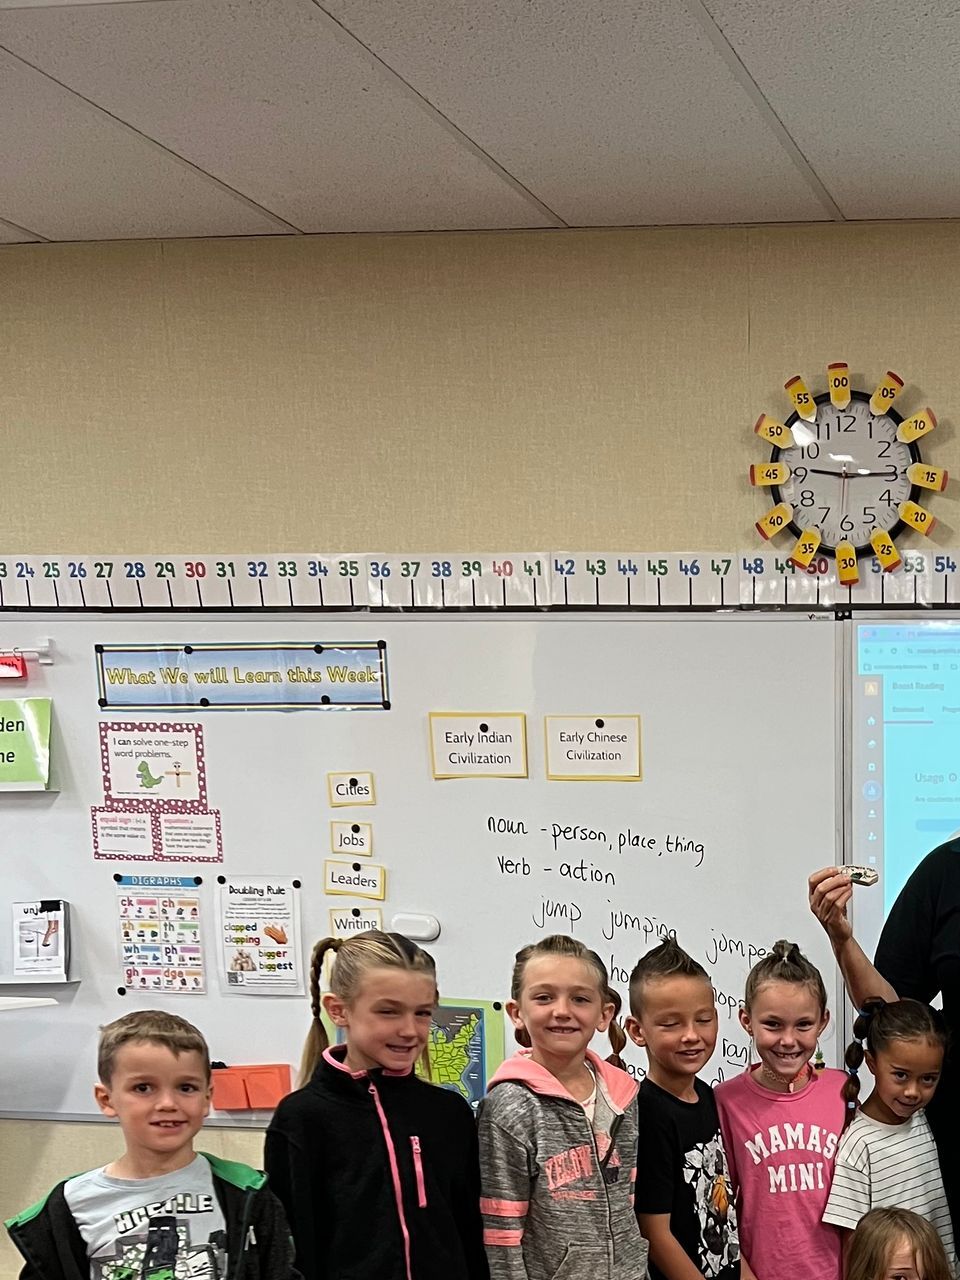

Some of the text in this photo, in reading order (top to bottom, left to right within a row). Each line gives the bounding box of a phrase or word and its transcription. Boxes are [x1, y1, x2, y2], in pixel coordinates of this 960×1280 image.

[816, 423, 831, 440] 11
[836, 416, 856, 432] 12
[800, 442, 819, 460] 10
[878, 441, 891, 458] 2
[794, 467, 808, 484] 9
[800, 490, 815, 507] 8
[879, 490, 894, 507] 4
[818, 507, 830, 524] 7
[840, 515, 854, 532] 6
[863, 507, 876, 524] 5
[16, 563, 34, 577] 24
[43, 563, 60, 577] 25
[68, 563, 86, 577] 26
[94, 563, 113, 577] 27
[124, 563, 145, 577] 28
[155, 562, 175, 577] 29
[185, 562, 205, 577] 30
[216, 562, 235, 577] 31
[248, 562, 268, 577] 32
[278, 561, 297, 576] 33
[308, 561, 328, 576] 34
[339, 561, 359, 576] 35
[370, 562, 390, 577] 36
[401, 562, 420, 577] 37
[432, 562, 451, 577] 38
[462, 561, 481, 576] 39
[493, 561, 513, 576] 40
[524, 560, 541, 576] 41
[555, 560, 575, 575] 42
[586, 560, 606, 575] 43
[618, 560, 638, 575] 44
[648, 560, 668, 575] 45
[680, 560, 700, 575] 46
[712, 560, 731, 575] 47
[743, 558, 764, 574] 48
[775, 558, 796, 574] 49
[807, 557, 829, 574] 50
[904, 557, 925, 572] 53
[935, 556, 956, 572] 54
[106, 666, 378, 684] What We will Learn this Week
[113, 738, 188, 750] I can solve one-step
[445, 731, 513, 746] Early Indian
[559, 731, 628, 746] Early Chinese
[114, 750, 172, 760] word problems.
[448, 752, 512, 765] Civilization
[566, 750, 622, 762] Civilization
[336, 782, 370, 796] Cities
[338, 833, 364, 847] Jobs
[488, 816, 705, 868] noun thing
[132, 876, 182, 886] DIGRAPHS
[330, 872, 378, 889] Leaders
[559, 859, 616, 886] action
[229, 886, 286, 896] Doubling Rule
[532, 895, 582, 932] jump
[224, 922, 258, 934] clapped
[334, 917, 378, 932] Writing
[224, 935, 261, 946] clapping
[258, 950, 288, 960] bigger
[259, 961, 293, 972] biggest
[744, 1122, 838, 1166] MAMA'S
[768, 1162, 825, 1193] MINI
